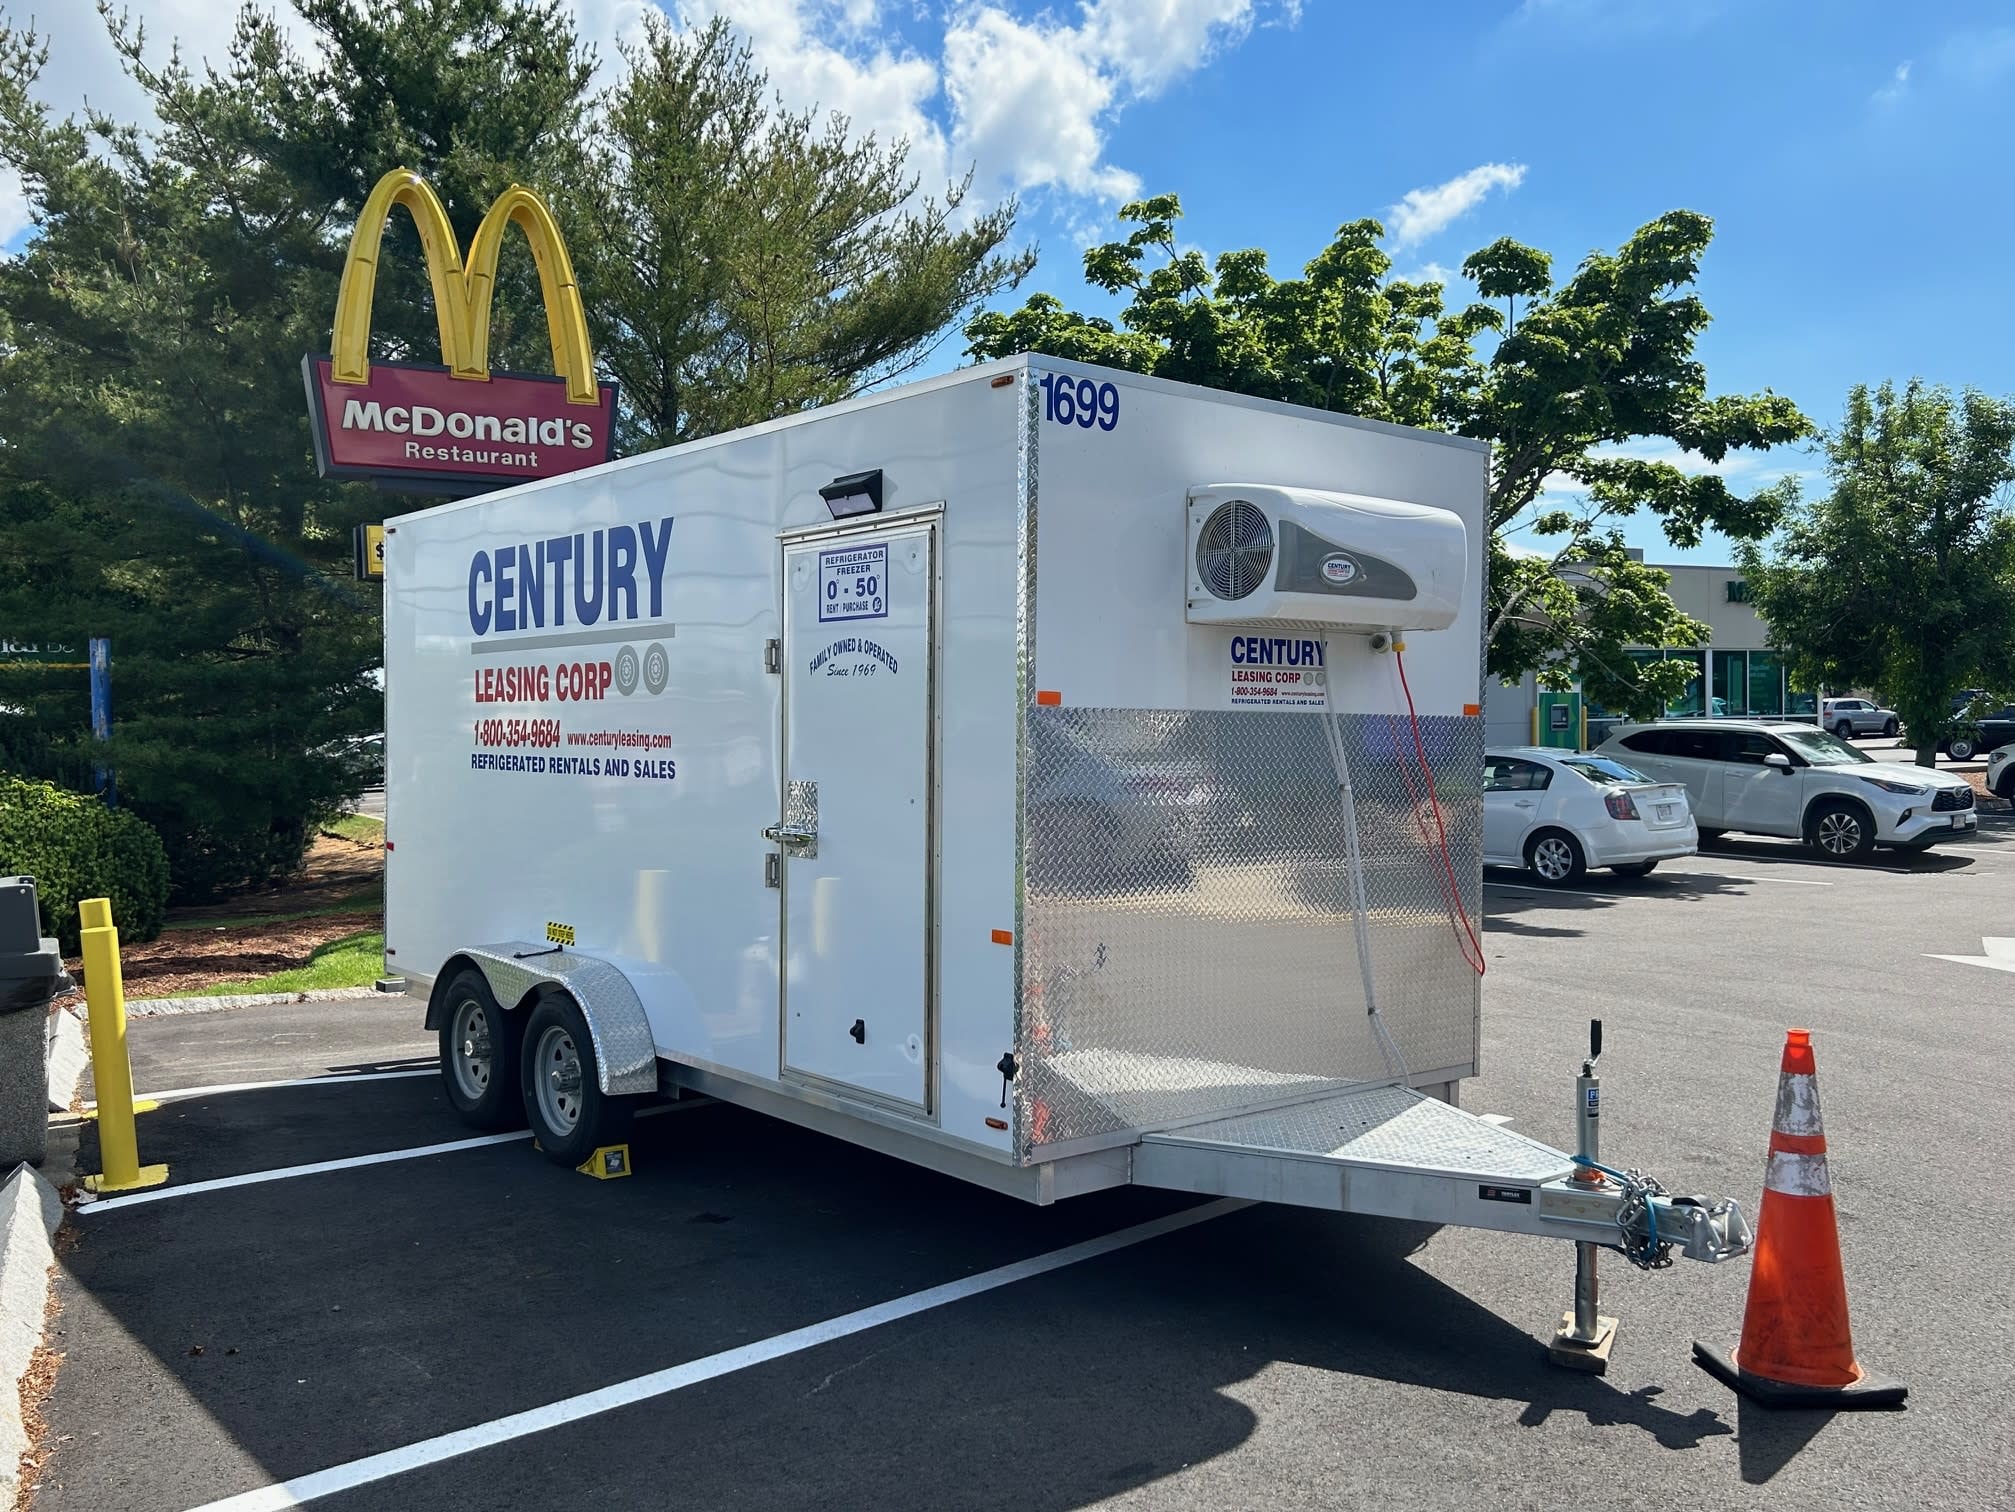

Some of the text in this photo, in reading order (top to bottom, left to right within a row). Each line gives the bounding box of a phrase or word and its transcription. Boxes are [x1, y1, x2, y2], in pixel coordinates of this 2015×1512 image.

[1039, 372, 1120, 432] 1699
[342, 399, 593, 449] McDonald's
[405, 441, 538, 468] Restaurant
[825, 550, 884, 565] REFRIGERATOR
[836, 564, 871, 576] FREEZER
[1327, 562, 1351, 570] CENTURY
[468, 516, 675, 636] CENTURY
[826, 604, 839, 614] RENT
[842, 600, 869, 613] PURCHASE
[809, 638, 898, 676] FAMILY OWNED & OPERATED
[1231, 636, 1328, 667] CENTURY
[474, 661, 612, 703] LEASING CORP
[827, 664, 876, 677] Since 1969
[1232, 670, 1301, 684] LEASING CORP
[1231, 686, 1278, 697] 1-800-354-9684
[474, 719, 672, 752] 1-800-354-9684 www.centuryleasing.com
[471, 753, 676, 780] REFRIGERATED RENTALS AND SALES
